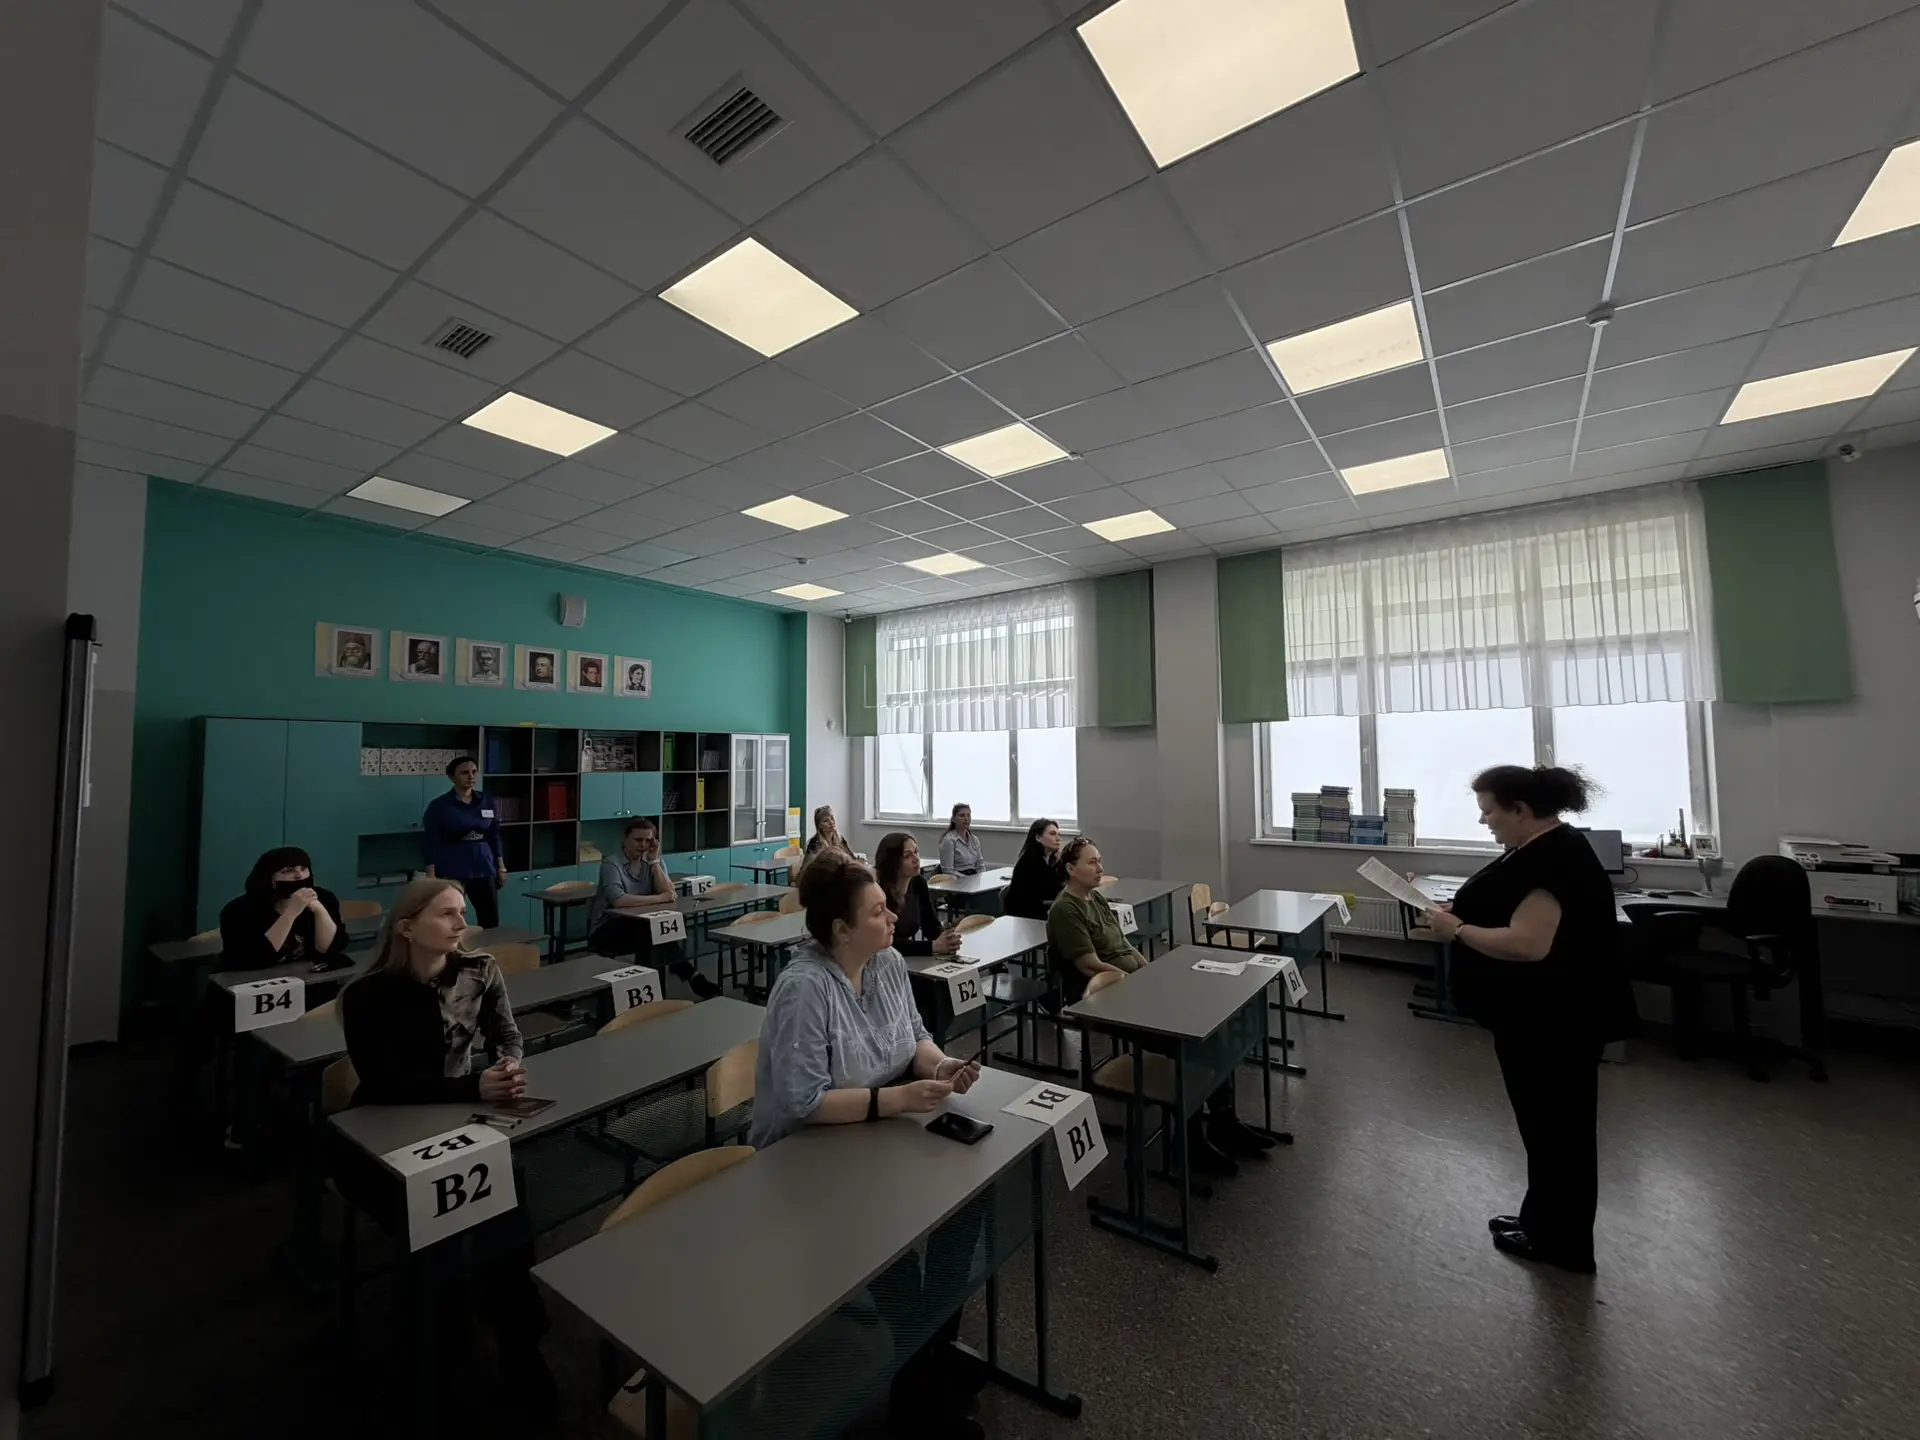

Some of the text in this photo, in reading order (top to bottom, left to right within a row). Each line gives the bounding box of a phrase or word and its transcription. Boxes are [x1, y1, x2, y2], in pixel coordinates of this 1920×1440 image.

[659, 919, 678, 935] Б4
[957, 979, 977, 1003] Б2
[1288, 969, 1301, 991] Б1
[252, 989, 292, 1015] В4
[625, 984, 654, 1009] В3
[412, 1133, 480, 1160] В2
[1066, 1117, 1096, 1164] В1
[431, 1163, 492, 1218] В2
